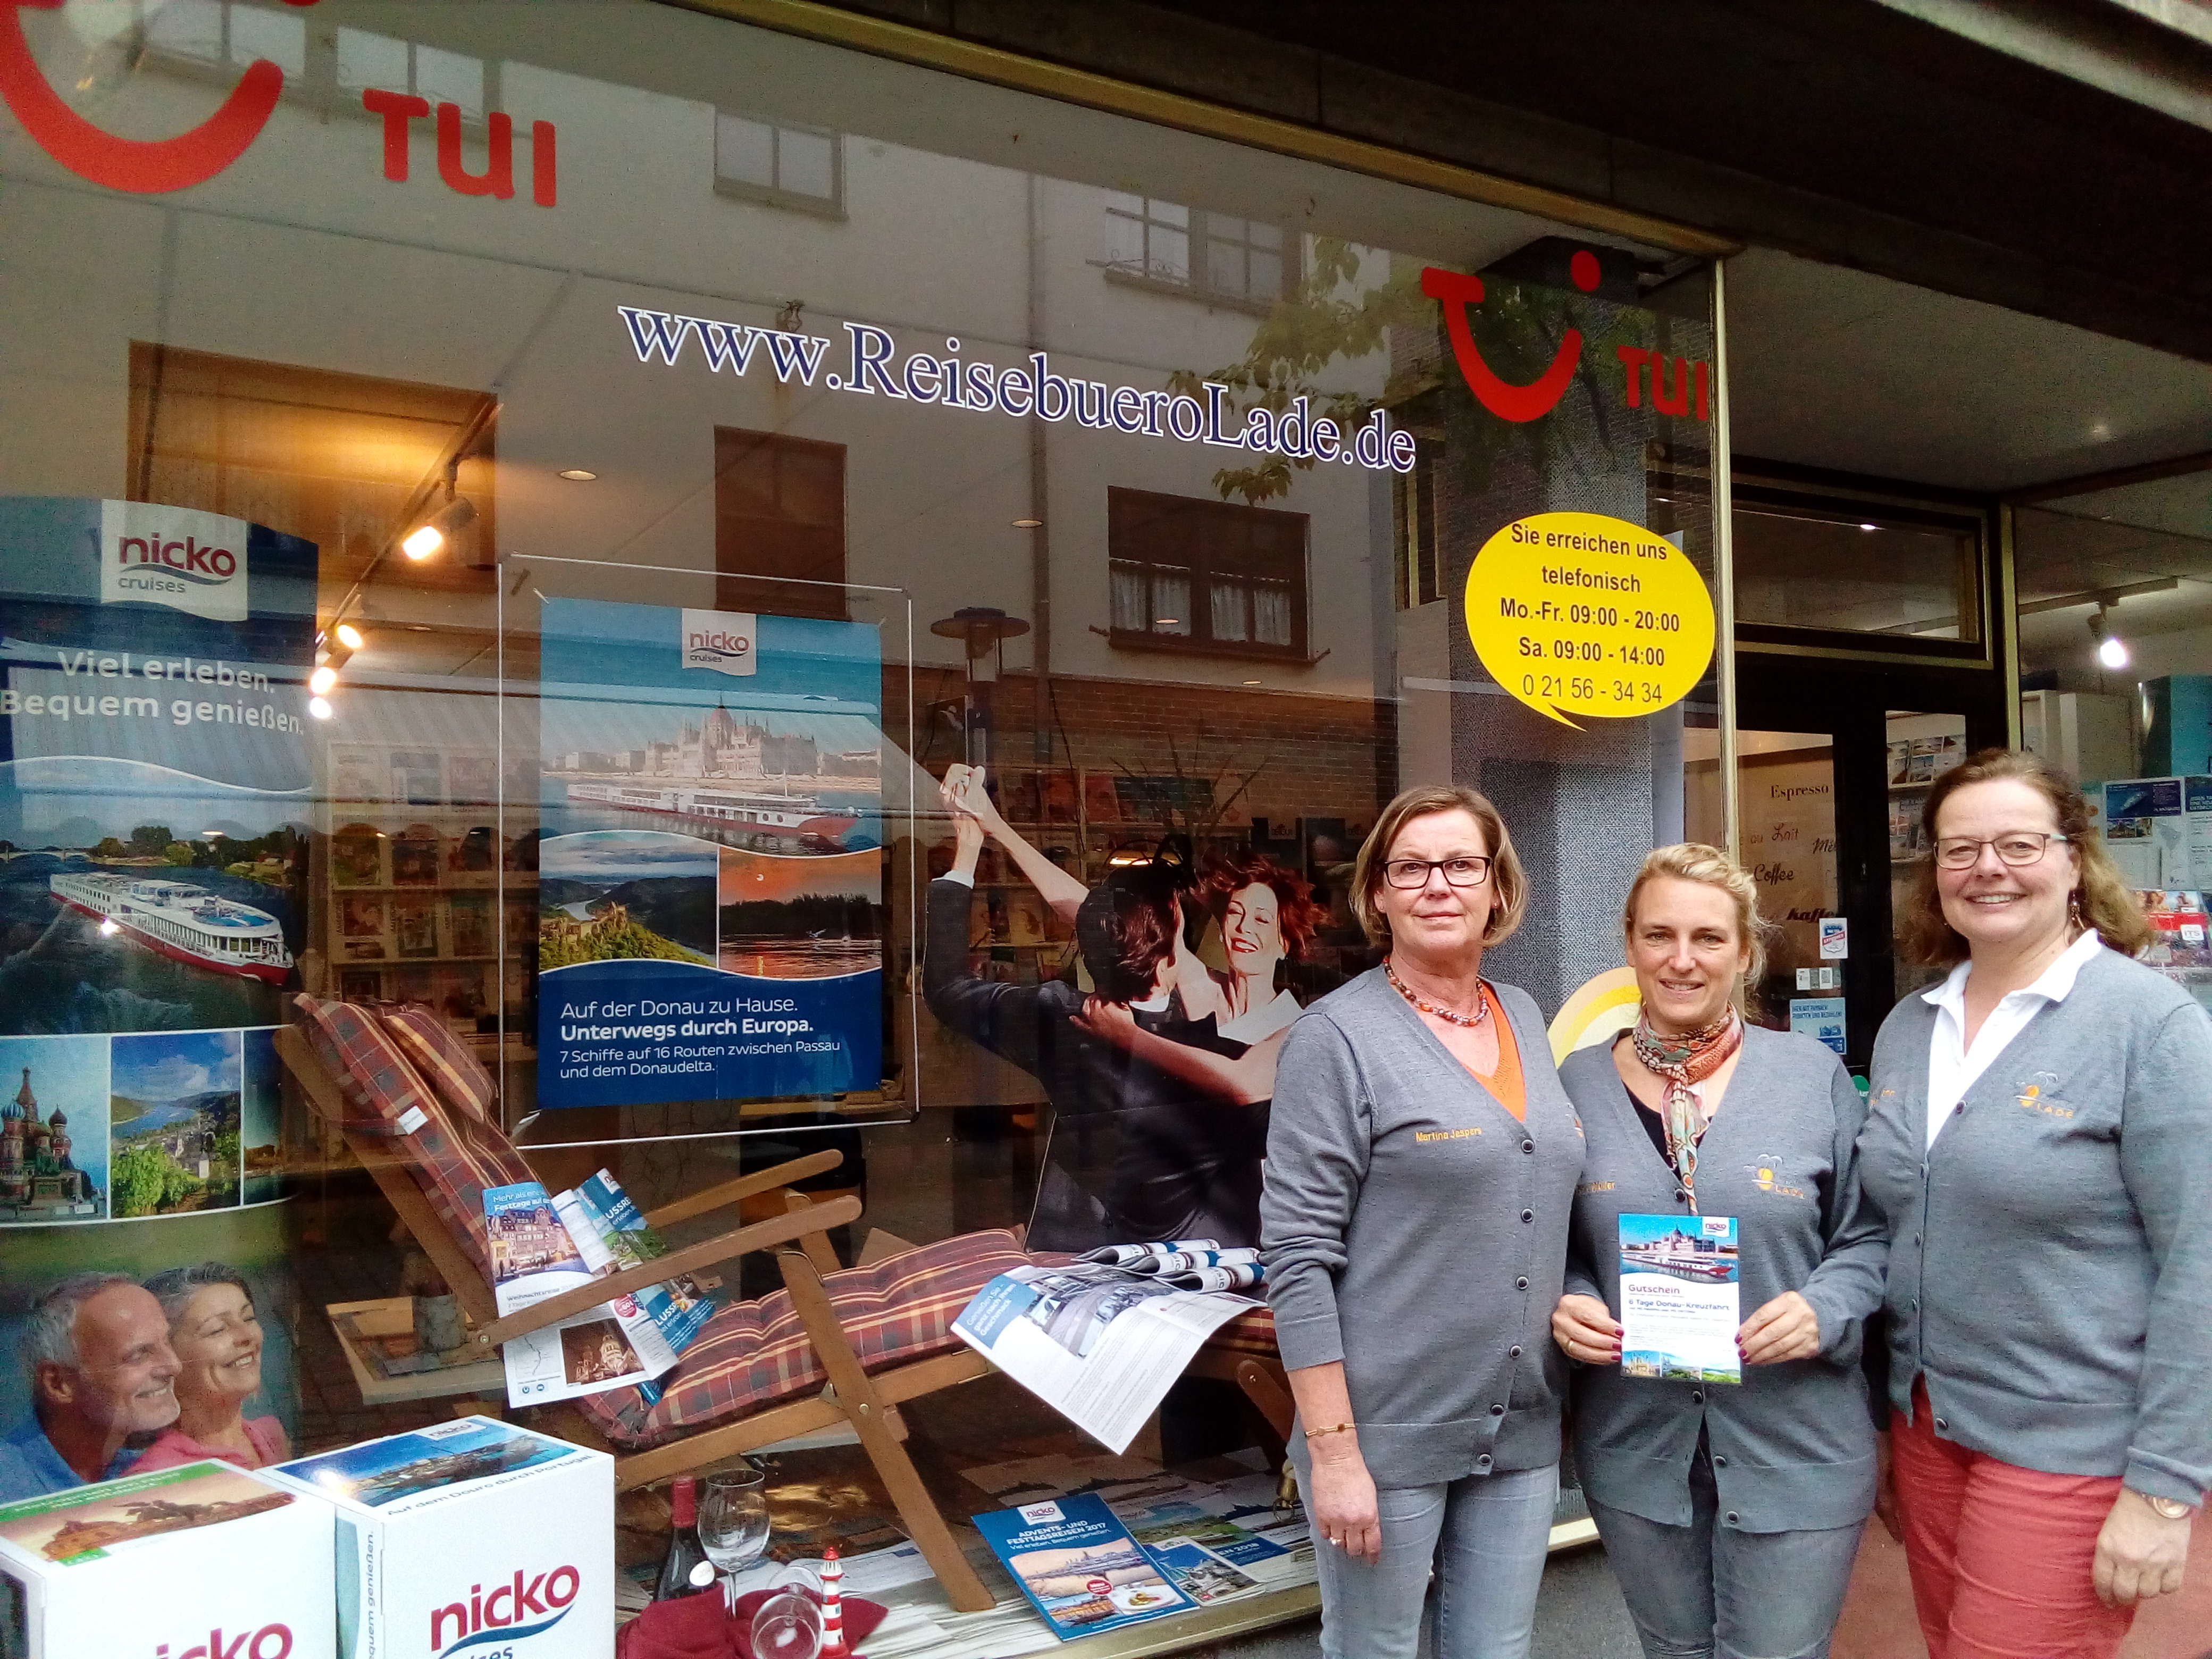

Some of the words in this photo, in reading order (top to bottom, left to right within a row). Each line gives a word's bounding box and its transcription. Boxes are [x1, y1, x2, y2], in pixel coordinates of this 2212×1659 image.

[363, 88, 556, 207] TUI
[617, 306, 1415, 473] www.ReisebueroLade.de
[1617, 345, 1708, 421] TUI
[1511, 523, 1540, 546] Sie
[1546, 532, 1630, 556] erreichen
[1637, 542, 1668, 560] uns
[119, 532, 236, 577] nicko
[119, 575, 186, 593] cruises
[1541, 565, 1641, 593] telefonisch
[1501, 597, 1564, 623] Mo.-Fr.
[1571, 604, 1618, 627] 09:00
[1635, 610, 1680, 633] 20:00
[690, 630, 749, 651] nicko
[1519, 636, 1548, 658] Sa.
[1554, 640, 1602, 662] 09:00
[1620, 645, 1665, 667] 14:00
[57, 651, 133, 678] Viel
[1523, 674, 1535, 696] 0
[1541, 675, 1562, 698] 21
[1571, 677, 1594, 699] 56
[1613, 680, 1635, 702] 34
[1641, 682, 1662, 703] 34
[1, 689, 158, 722] Bequem
[171, 699, 304, 736] genießen.
[1771, 785, 1829, 801] Espresso
[1772, 823, 1799, 841] Lait
[1754, 864, 1795, 886] Coffee
[560, 1001, 598, 1019] Auf
[602, 1001, 636, 1018] der
[641, 1000, 704, 1016] Donau
[709, 1001, 731, 1014] zu
[736, 998, 798, 1013] Hause.
[561, 1024, 676, 1041] Unterwegs
[681, 1018, 737, 1036] durch
[742, 1018, 814, 1036] Europa.
[560, 1050, 568, 1063] 7
[572, 1048, 624, 1062] Schiffe
[627, 1047, 651, 1060] auf
[653, 1046, 670, 1059] 16
[674, 1044, 724, 1058] Routen
[728, 1042, 792, 1055] zwischen
[796, 1041, 840, 1052] Passau
[560, 1065, 589, 1078] und
[592, 1065, 626, 1077] dem
[630, 1060, 715, 1076] Donaudelta.
[1415, 1132, 1449, 1142] Martina
[494, 1200, 531, 1211] Festtage
[1628, 1285, 1680, 1294] Gutschein
[1656, 1301, 1730, 1311] Donau-Kreuzfahrt
[388, 1505, 413, 1515] Auf
[415, 1495, 447, 1509] dem
[449, 1482, 494, 1498] Douro
[496, 1469, 536, 1486] durch
[537, 1454, 596, 1474] Portugal.
[1026, 1507, 1055, 1517] nicko
[1007, 1527, 1085, 1545] FESTTAGSREISEN
[1085, 1522, 1107, 1531] 2017
[1019, 1524, 1065, 1538] ADVENTS-
[1066, 1520, 1088, 1529] UND
[365, 1531, 376, 1606] genießen.
[431, 1564, 580, 1652] nicko
